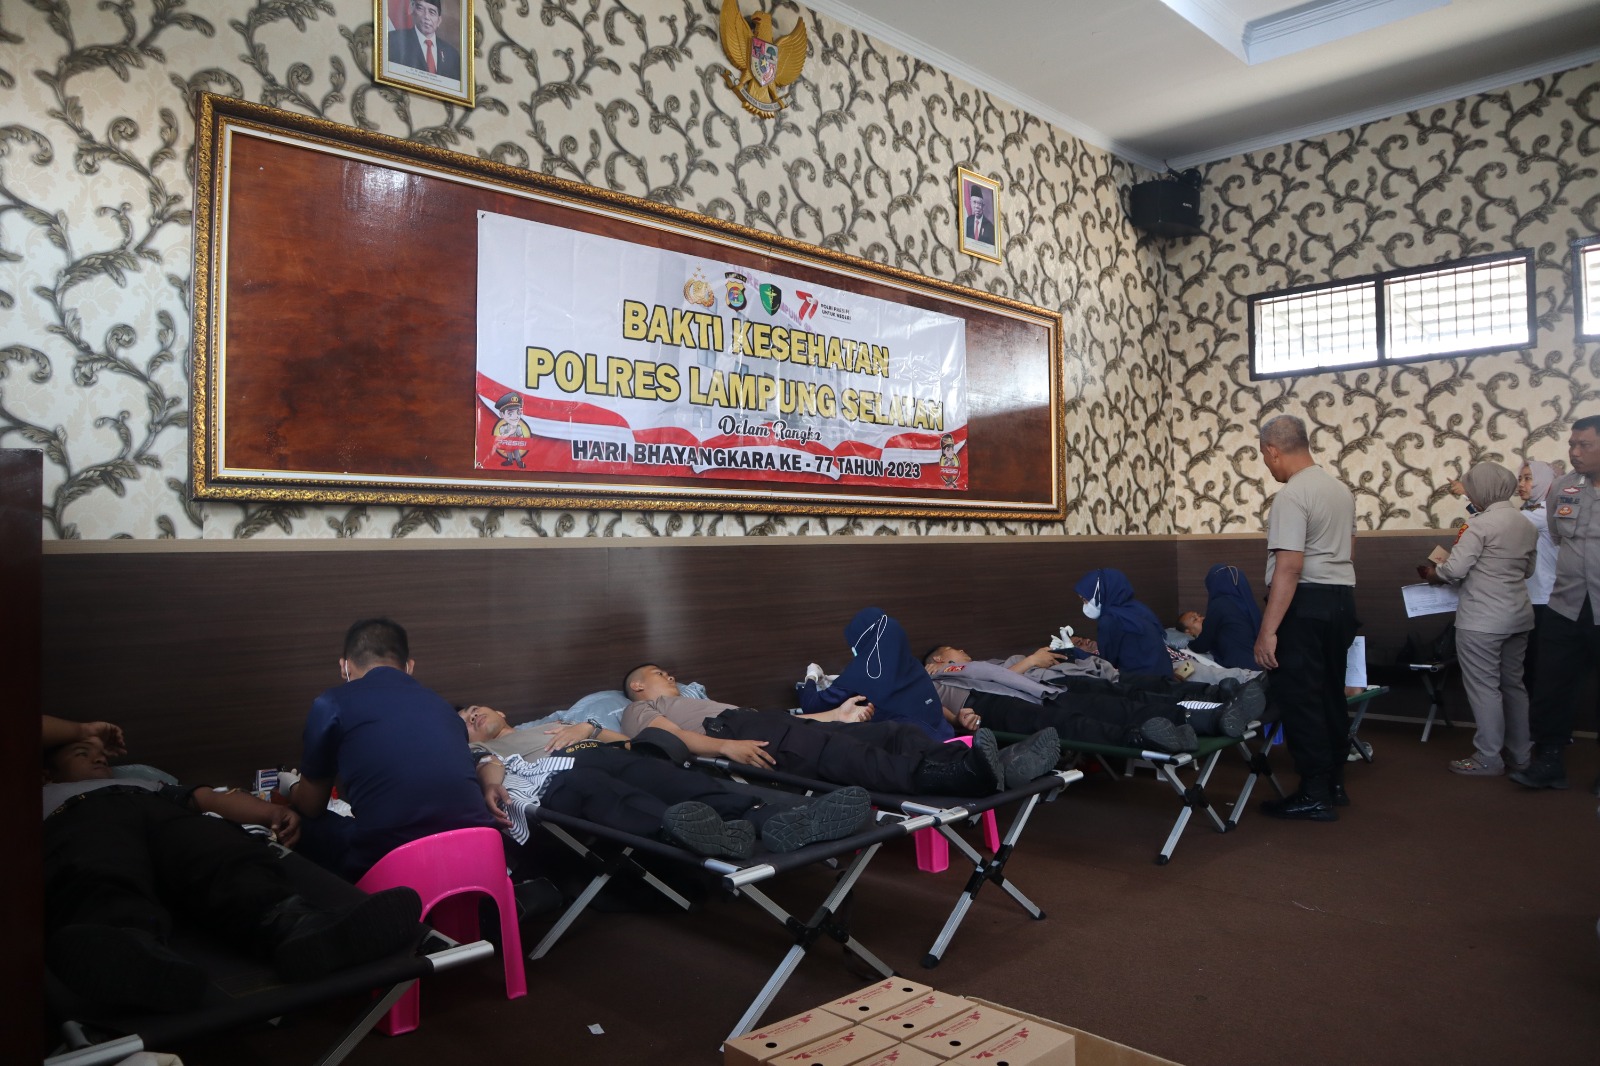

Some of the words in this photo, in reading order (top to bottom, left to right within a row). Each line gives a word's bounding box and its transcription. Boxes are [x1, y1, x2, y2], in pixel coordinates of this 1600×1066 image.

[622, 299, 724, 352] BAKTI
[732, 317, 890, 379] KESEHATAN
[525, 347, 681, 402] POLRES
[689, 366, 836, 419] LAMPUNG
[840, 388, 945, 432] SELATAN
[497, 439, 527, 447] PRESISI
[718, 415, 769, 437] Dalam
[773, 420, 822, 445] Rangka
[572, 439, 628, 463] HARI
[633, 443, 776, 471] BHAYANGKARA
[779, 453, 802, 471] KE
[814, 456, 834, 473] 77
[837, 457, 884, 477] TAHUN
[887, 460, 922, 479] 2023
[574, 742, 599, 751] POLISI
